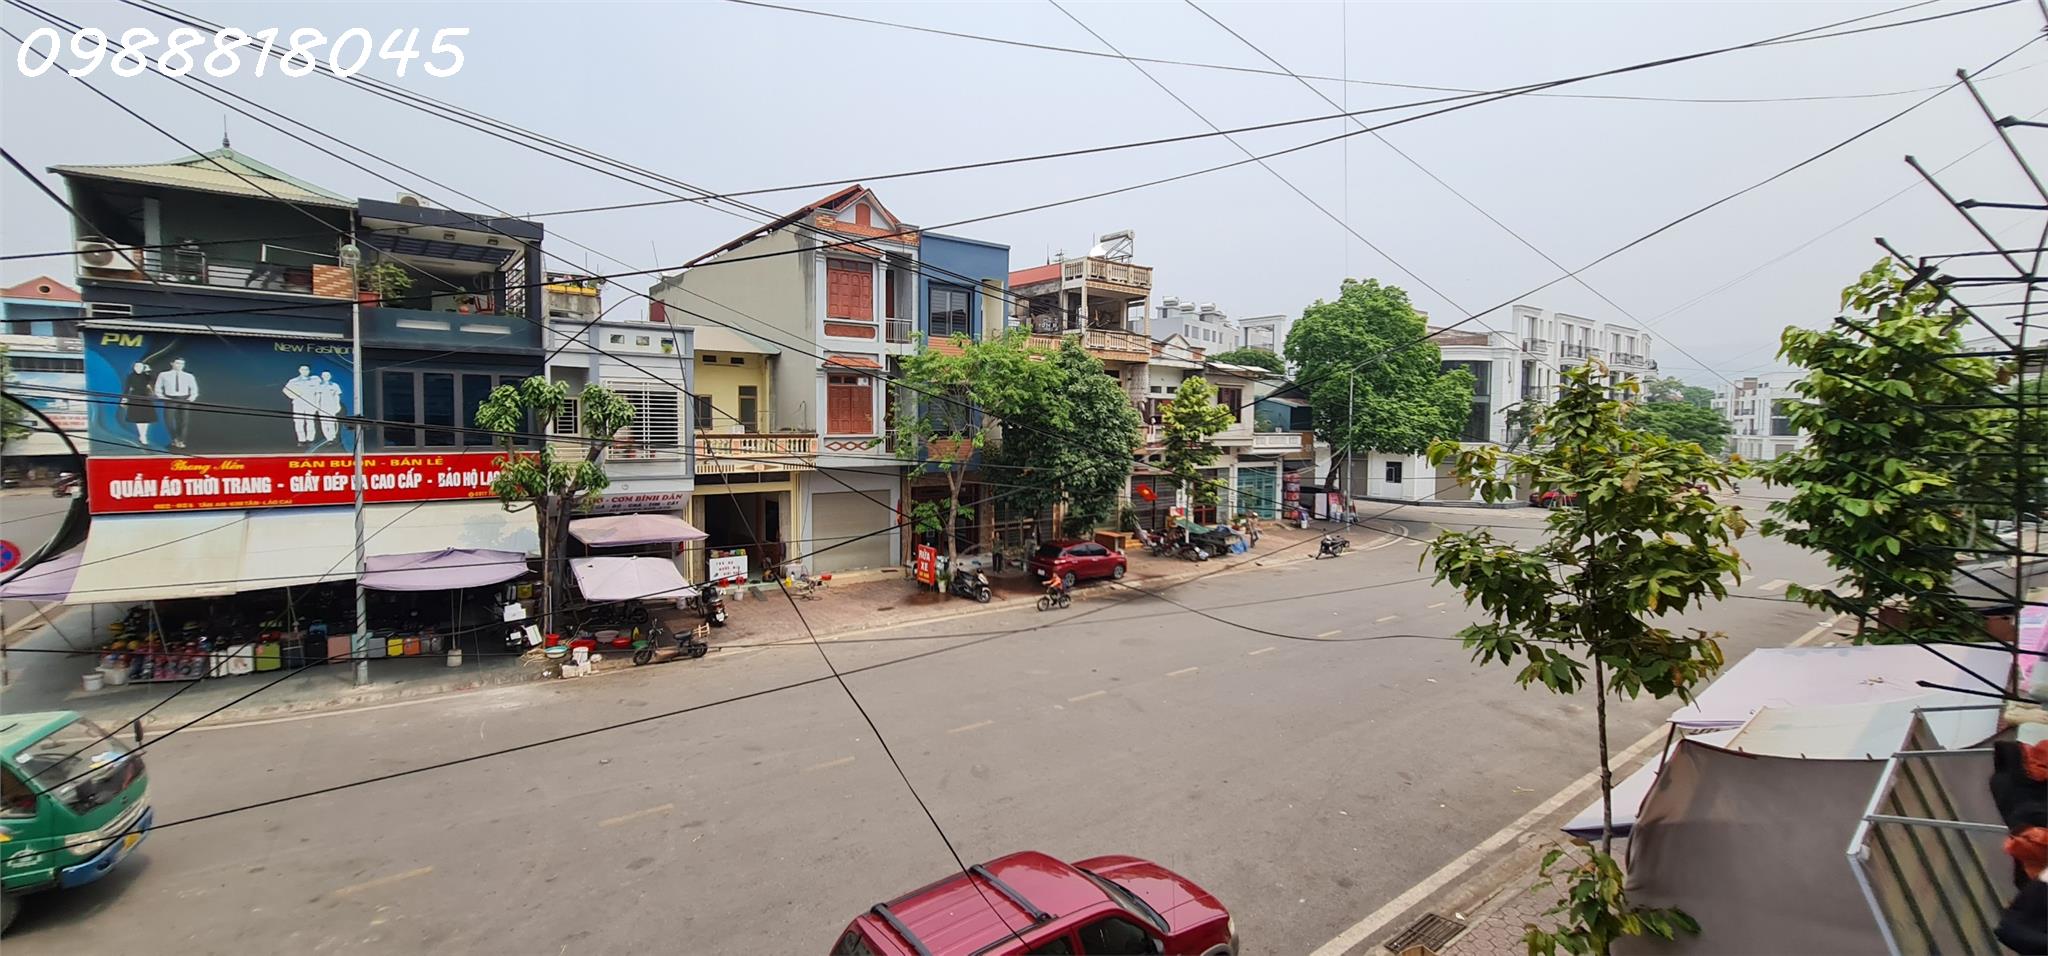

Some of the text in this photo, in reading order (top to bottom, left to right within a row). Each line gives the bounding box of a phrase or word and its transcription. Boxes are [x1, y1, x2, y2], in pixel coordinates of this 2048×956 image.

[100, 332, 143, 347] PM
[274, 342, 304, 352] New
[288, 459, 326, 469] BÁN
[390, 457, 423, 467] BÁN
[160, 475, 182, 496] ÁO
[184, 474, 220, 496] THỜI
[222, 476, 272, 495] TRANG
[323, 471, 348, 491] DÉP
[370, 473, 393, 490] CAO
[397, 467, 421, 489] CẤP
[463, 468, 478, 489] HỘ
